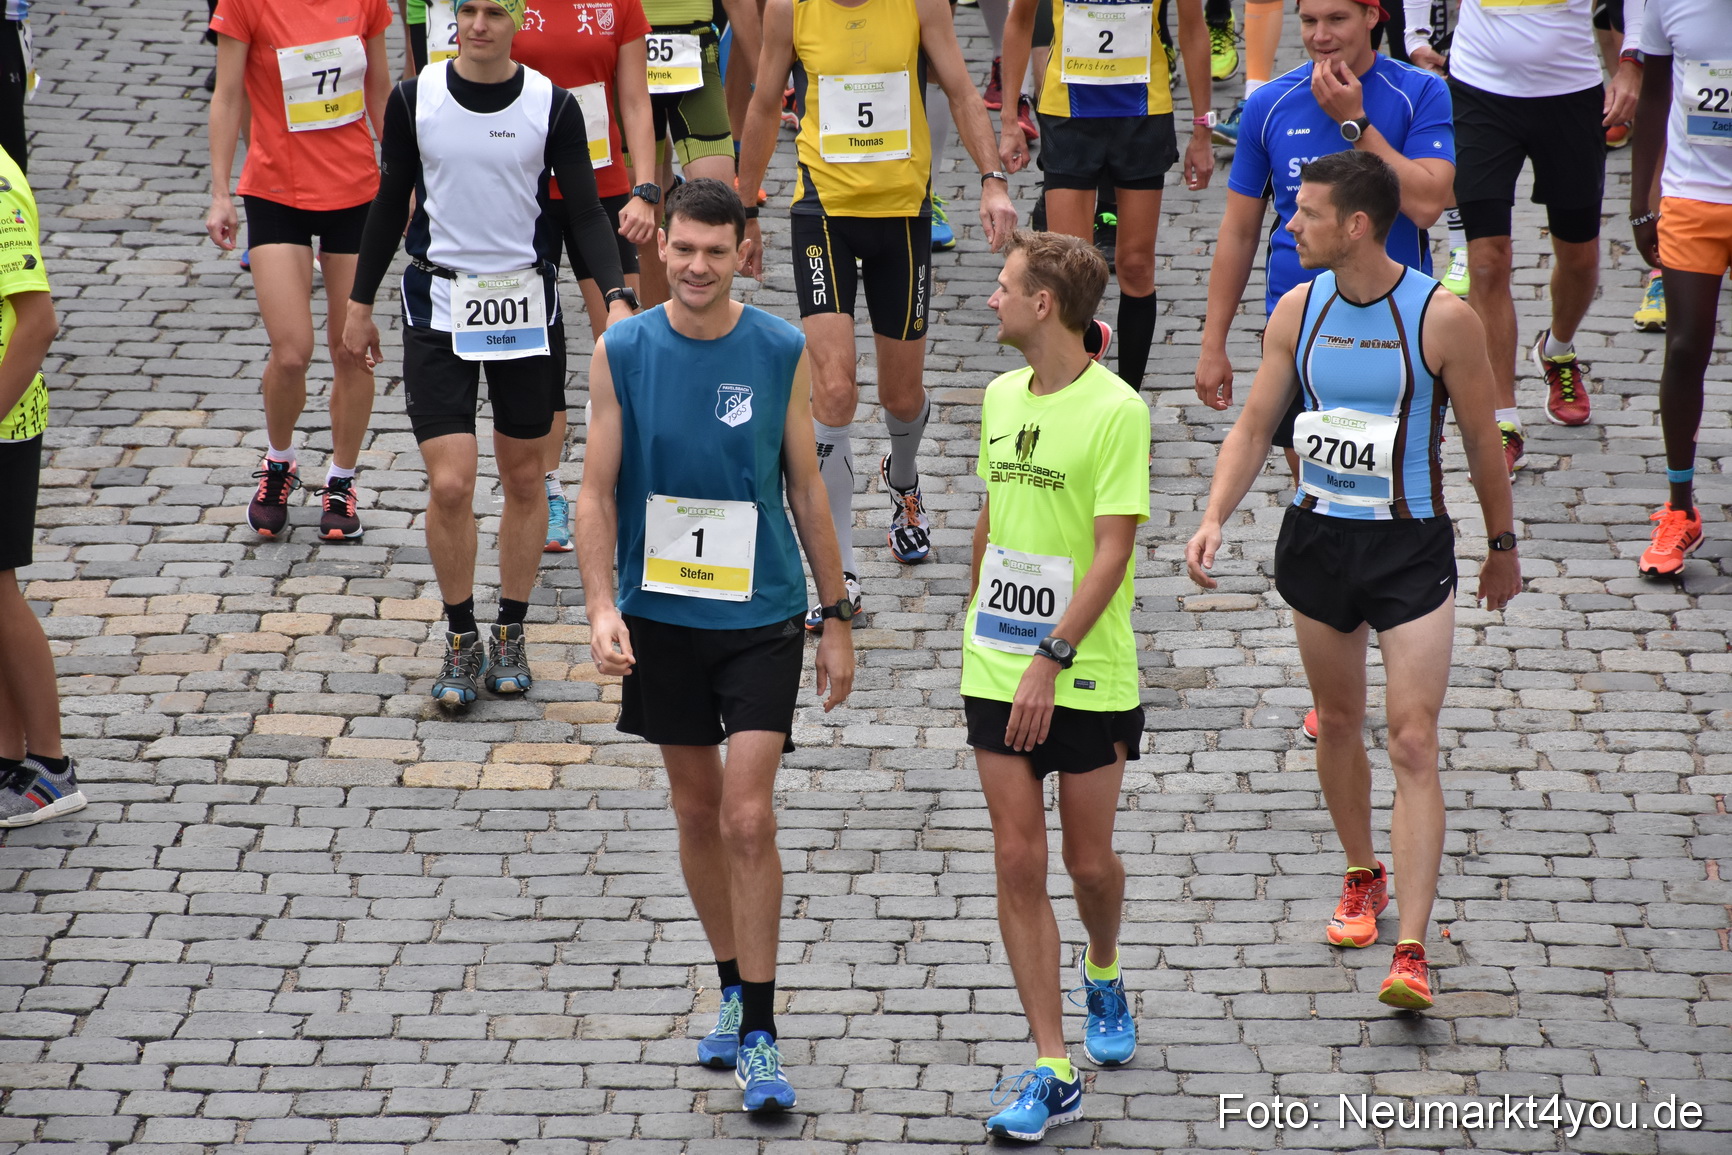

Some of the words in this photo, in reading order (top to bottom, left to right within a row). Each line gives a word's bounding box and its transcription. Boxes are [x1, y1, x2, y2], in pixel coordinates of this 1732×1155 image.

[1096, 12, 1126, 20] BOCK
[1098, 30, 1113, 53] 2
[313, 47, 341, 60] BOCK
[646, 38, 673, 62] 65
[1066, 59, 1116, 71] Christine
[312, 67, 341, 95] 77
[647, 71, 672, 80] Hynek
[853, 81, 885, 91] BOCK
[324, 103, 339, 113] Eva
[1697, 88, 1732, 113] 22
[858, 102, 874, 128] 5
[489, 130, 516, 138] Stefan
[848, 137, 884, 147] Thomas
[488, 279, 519, 289] BOCK
[809, 257, 826, 305] SKINS
[916, 264, 926, 318] SKINS
[465, 296, 529, 326] 2001
[486, 335, 516, 345] Stefan
[1381, 340, 1400, 349] RACER
[725, 392, 742, 413] TSV
[728, 404, 747, 423] 1965
[1331, 415, 1367, 430] BOCK
[1307, 434, 1375, 471] 2704
[1327, 474, 1356, 489] Marco
[687, 507, 725, 518] BOCK
[691, 528, 704, 558] 1
[680, 566, 714, 581] Stefan
[1010, 560, 1041, 574] BOCK
[988, 578, 1055, 617] 2000
[999, 622, 1037, 638] Michael
